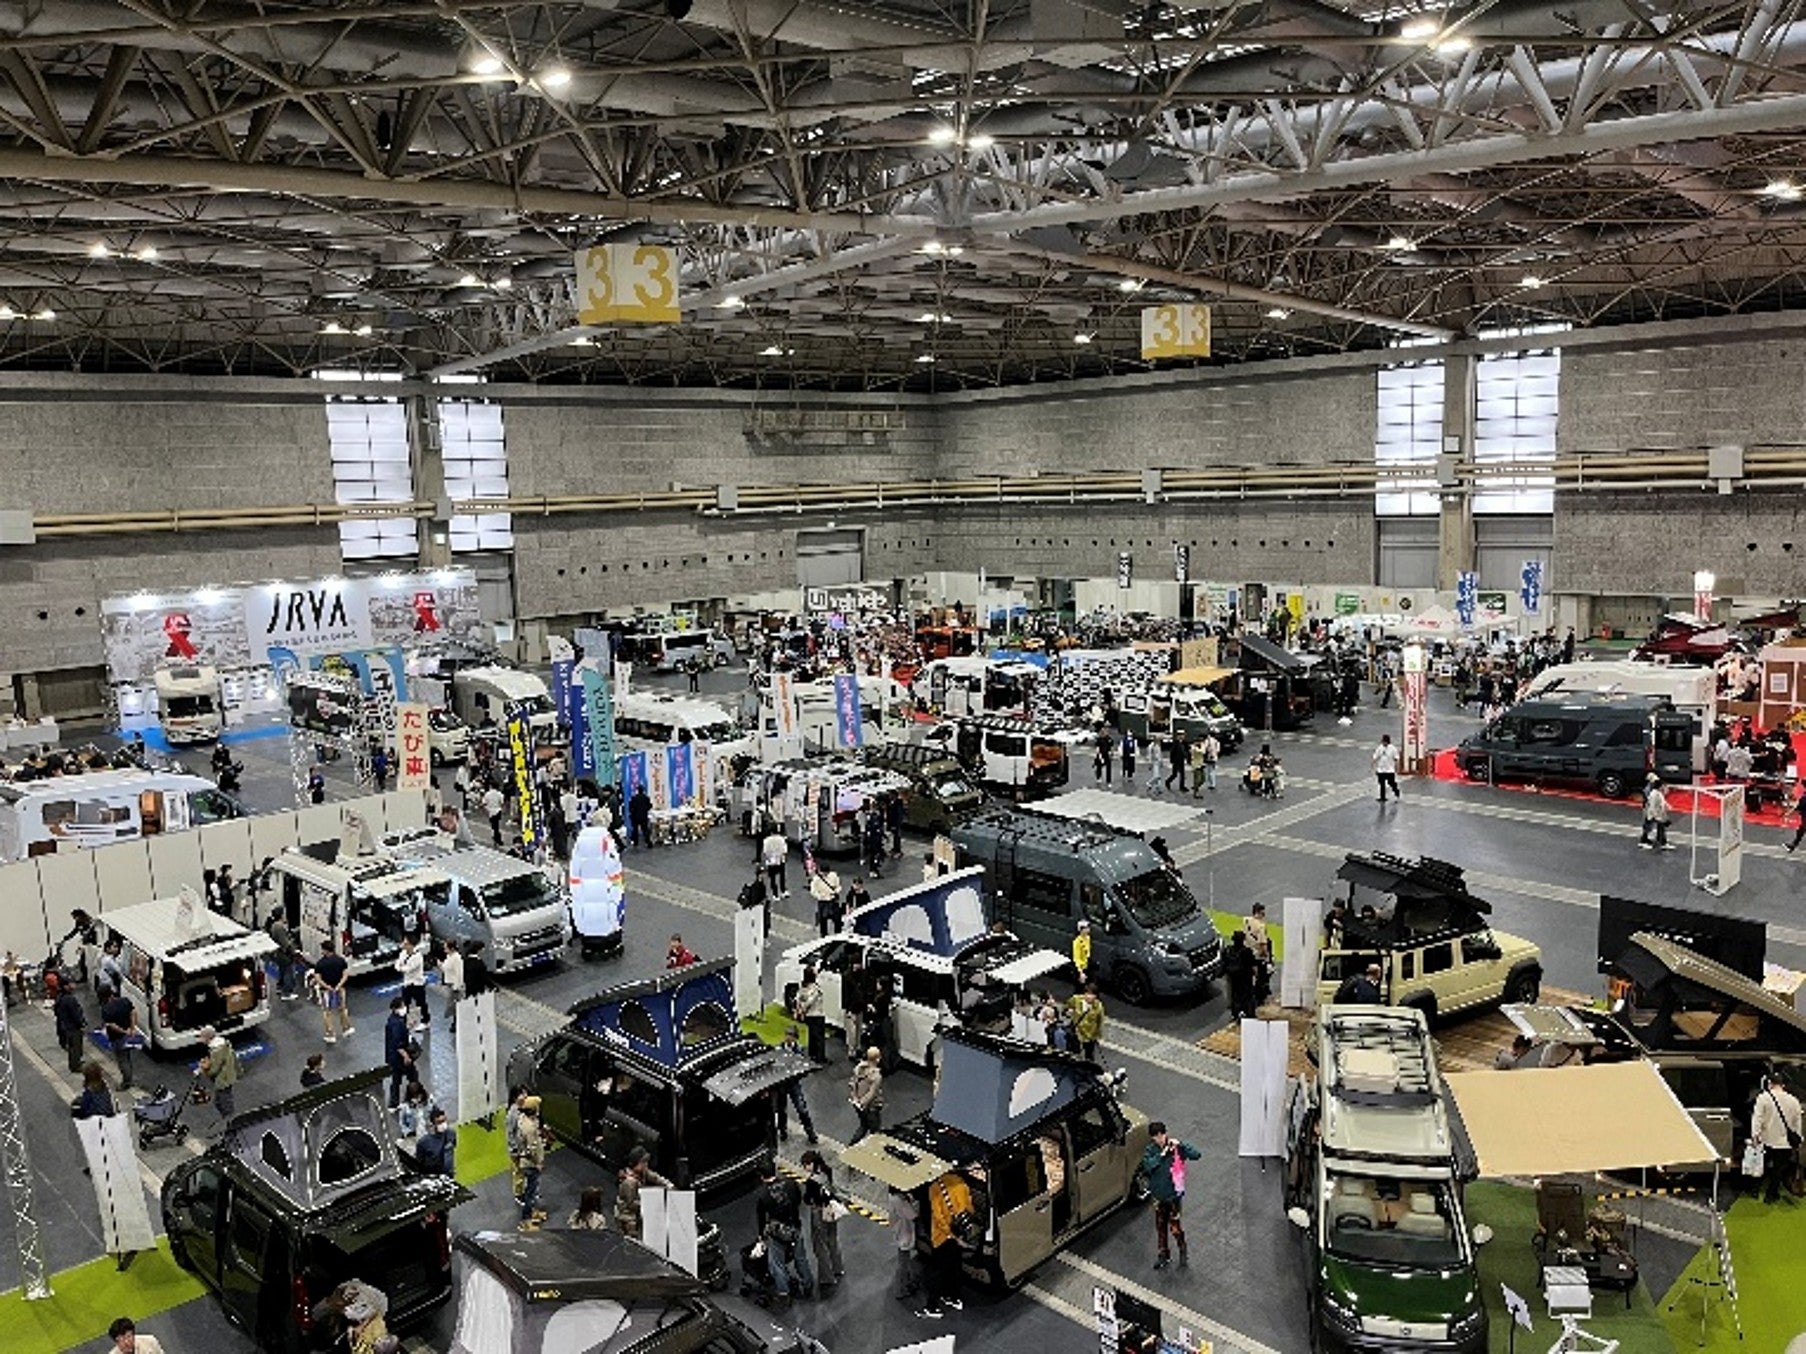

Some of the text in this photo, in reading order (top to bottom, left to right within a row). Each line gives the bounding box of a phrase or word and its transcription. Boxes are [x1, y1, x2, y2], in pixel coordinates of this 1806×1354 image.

[586, 246, 612, 310] 3
[633, 245, 673, 310] 3
[1153, 306, 1179, 347] 3
[1191, 305, 1208, 347] 3
[266, 589, 348, 634] JRVA
[403, 710, 424, 776] たび車
